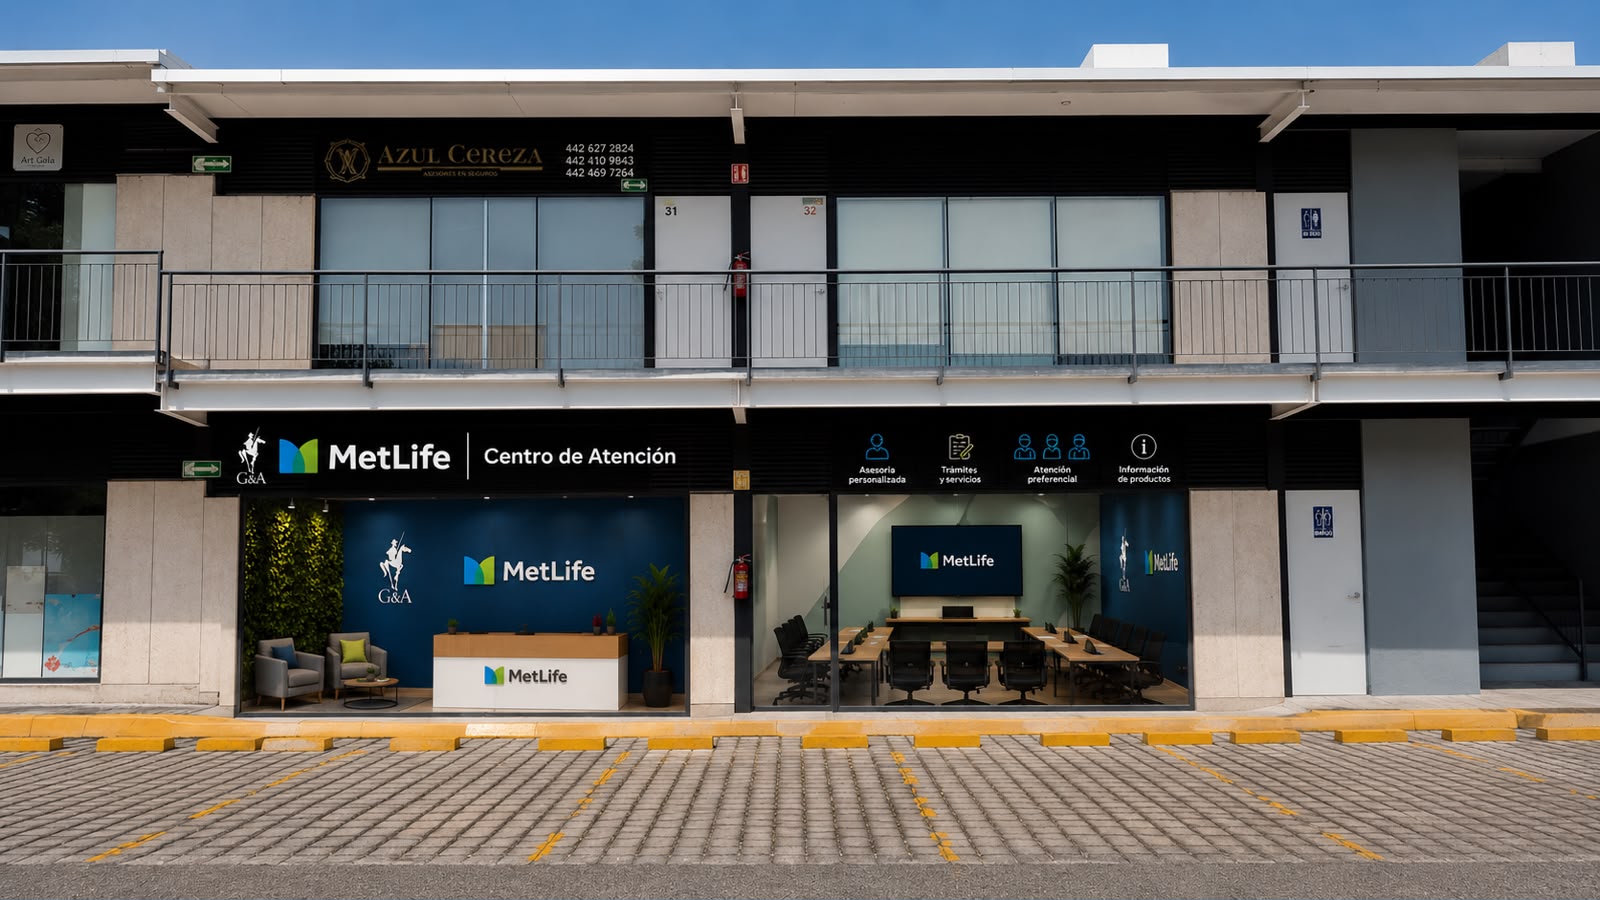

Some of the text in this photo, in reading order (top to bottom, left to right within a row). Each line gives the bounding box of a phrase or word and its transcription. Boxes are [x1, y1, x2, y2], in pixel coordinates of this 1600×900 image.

[566, 143, 634, 153] 442 627 2824
[20, 156, 34, 164] Art
[566, 156, 634, 165] 442 410 9843
[566, 168, 634, 177] 442 469 7264
[665, 207, 677, 216] 31
[804, 206, 817, 216] 32
[328, 444, 451, 470] MetLife
[484, 447, 676, 465] Centro de Atención
[940, 465, 978, 474] Trámites
[1033, 465, 1072, 474] Atención
[1119, 465, 1170, 474] Información
[236, 471, 267, 485] G&A
[848, 475, 907, 485] personalizada
[939, 475, 982, 485] y servicios
[1027, 475, 1078, 484] preferencial
[1117, 475, 1171, 485] de productos
[942, 554, 995, 567] MetLife
[1153, 552, 1179, 572] MetLife
[503, 559, 596, 582] MetLife
[378, 588, 412, 604] G&A
[508, 669, 568, 684] MetLife
